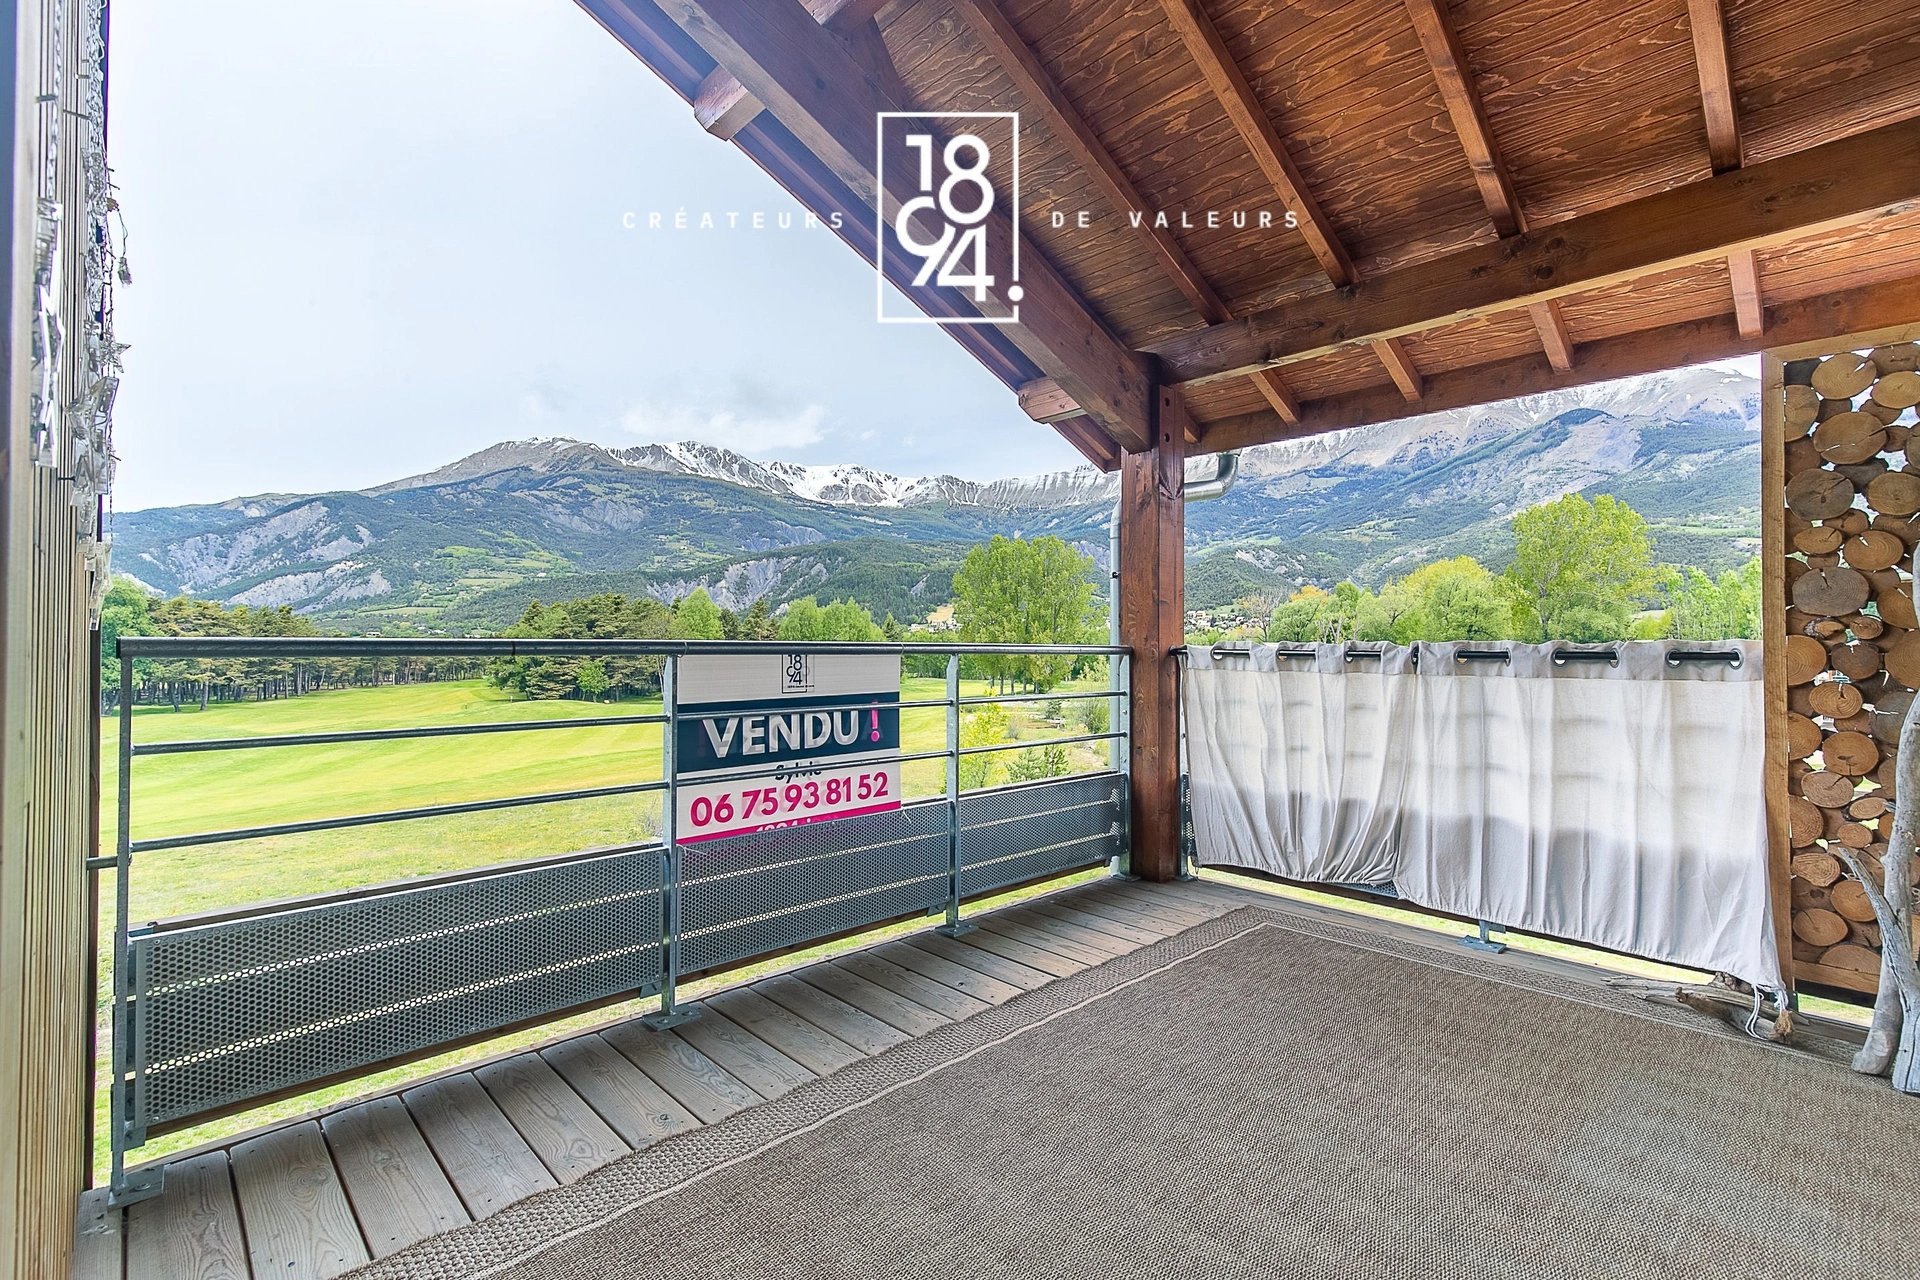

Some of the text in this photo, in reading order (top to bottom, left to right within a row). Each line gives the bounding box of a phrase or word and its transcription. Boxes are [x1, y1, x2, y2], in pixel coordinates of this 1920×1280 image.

[702, 710, 859, 758] VENDU
[690, 794, 734, 826] 06
[742, 787, 779, 820] 75
[784, 781, 820, 813] 93
[825, 777, 852, 805] 81
[858, 771, 889, 800] 52
